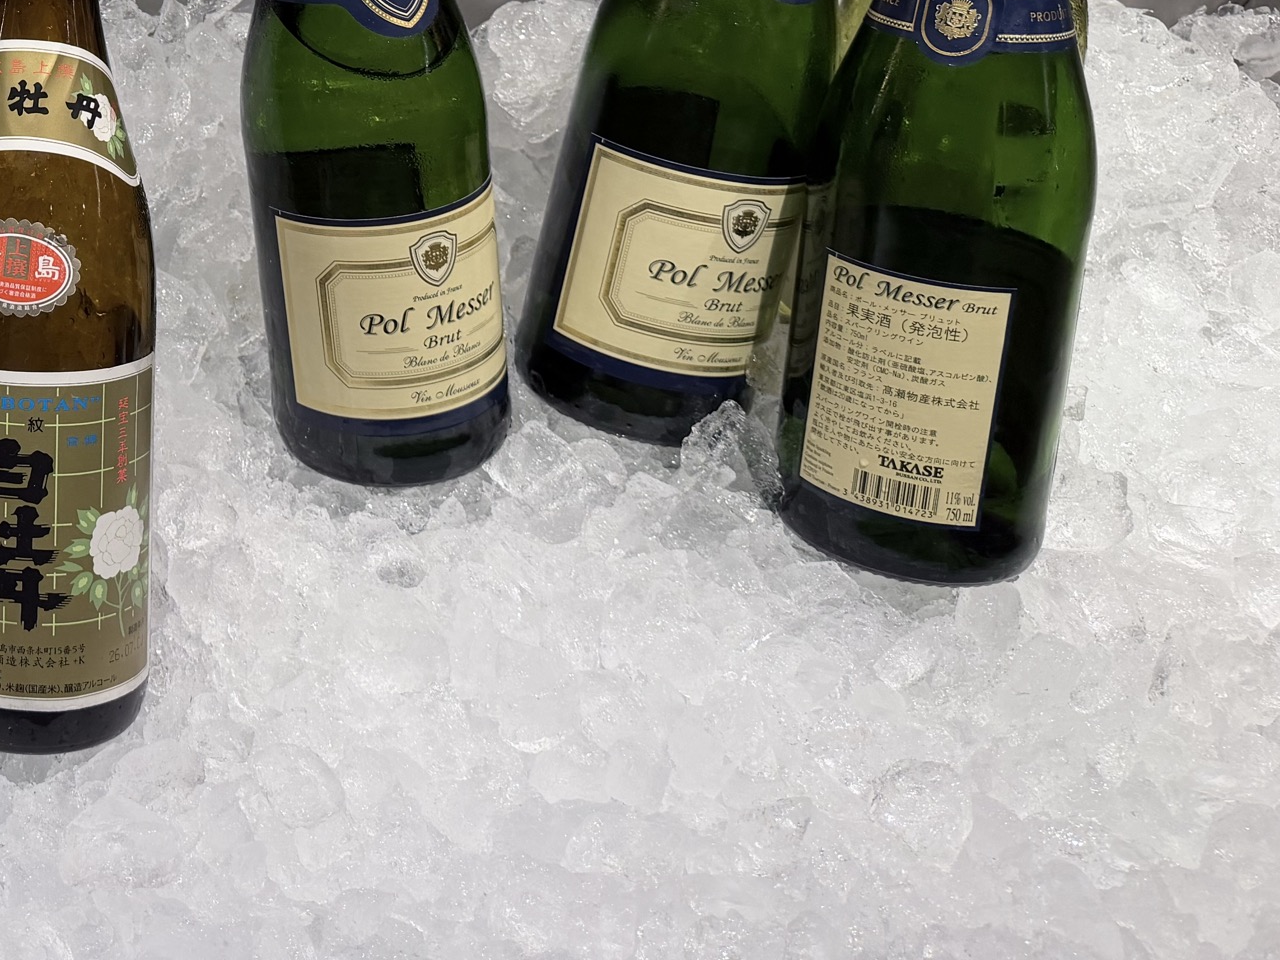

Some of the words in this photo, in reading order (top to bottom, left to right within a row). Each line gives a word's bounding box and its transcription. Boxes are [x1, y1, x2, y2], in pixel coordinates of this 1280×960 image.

[648, 259, 709, 288] Pol
[412, 290, 439, 303] Produced
[447, 284, 463, 295] France
[833, 265, 870, 290] Pol
[874, 280, 960, 312] Messer
[961, 302, 999, 316] Brut
[359, 306, 415, 336] Pol
[426, 281, 495, 329] Messer
[704, 298, 743, 312] Brut
[677, 311, 712, 326] Blanc
[713, 318, 725, 326] de
[423, 328, 462, 349] Brut
[403, 355, 437, 369] Blanc
[439, 351, 450, 361] de
[453, 340, 481, 358] Blancs
[674, 347, 694, 361] Vin
[411, 389, 432, 404] Vin
[878, 454, 944, 479] TAKASE
[842, 487, 849, 497] 3
[853, 492, 890, 511] 438931
[894, 504, 934, 519] 014723
[945, 491, 961, 506] 11%
[963, 493, 976, 507] vol.
[945, 507, 961, 522] 750
[962, 509, 975, 523] ml
